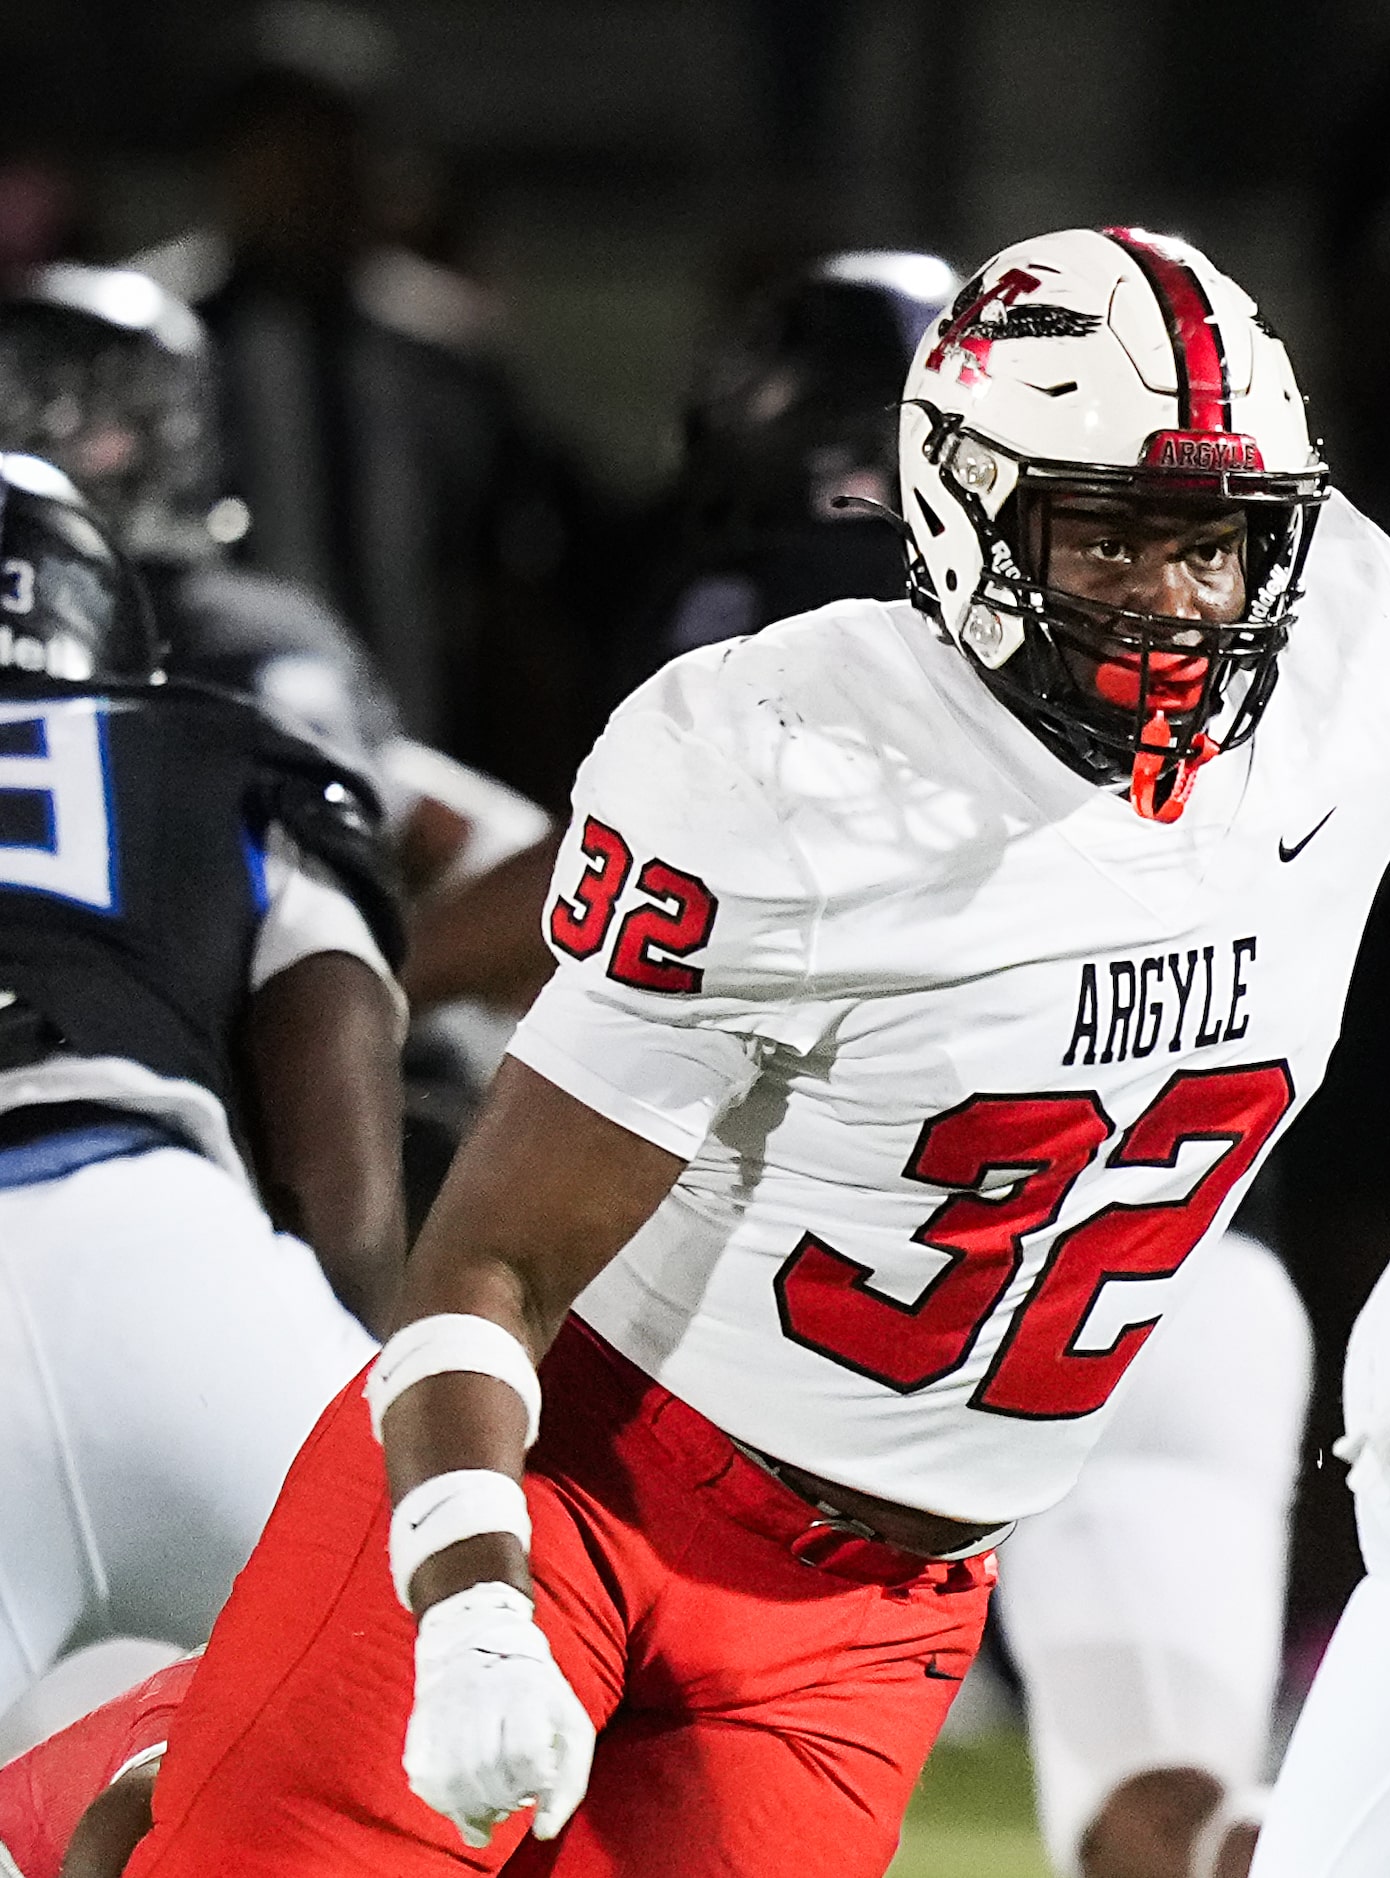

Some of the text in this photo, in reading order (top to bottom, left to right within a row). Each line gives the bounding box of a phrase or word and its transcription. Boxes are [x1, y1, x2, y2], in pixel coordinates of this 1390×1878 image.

[1160, 438, 1256, 472] ARGYLE
[550, 814, 719, 994] 32
[1062, 936, 1257, 1066] ARGYLE
[773, 1059, 1296, 1421] 32
